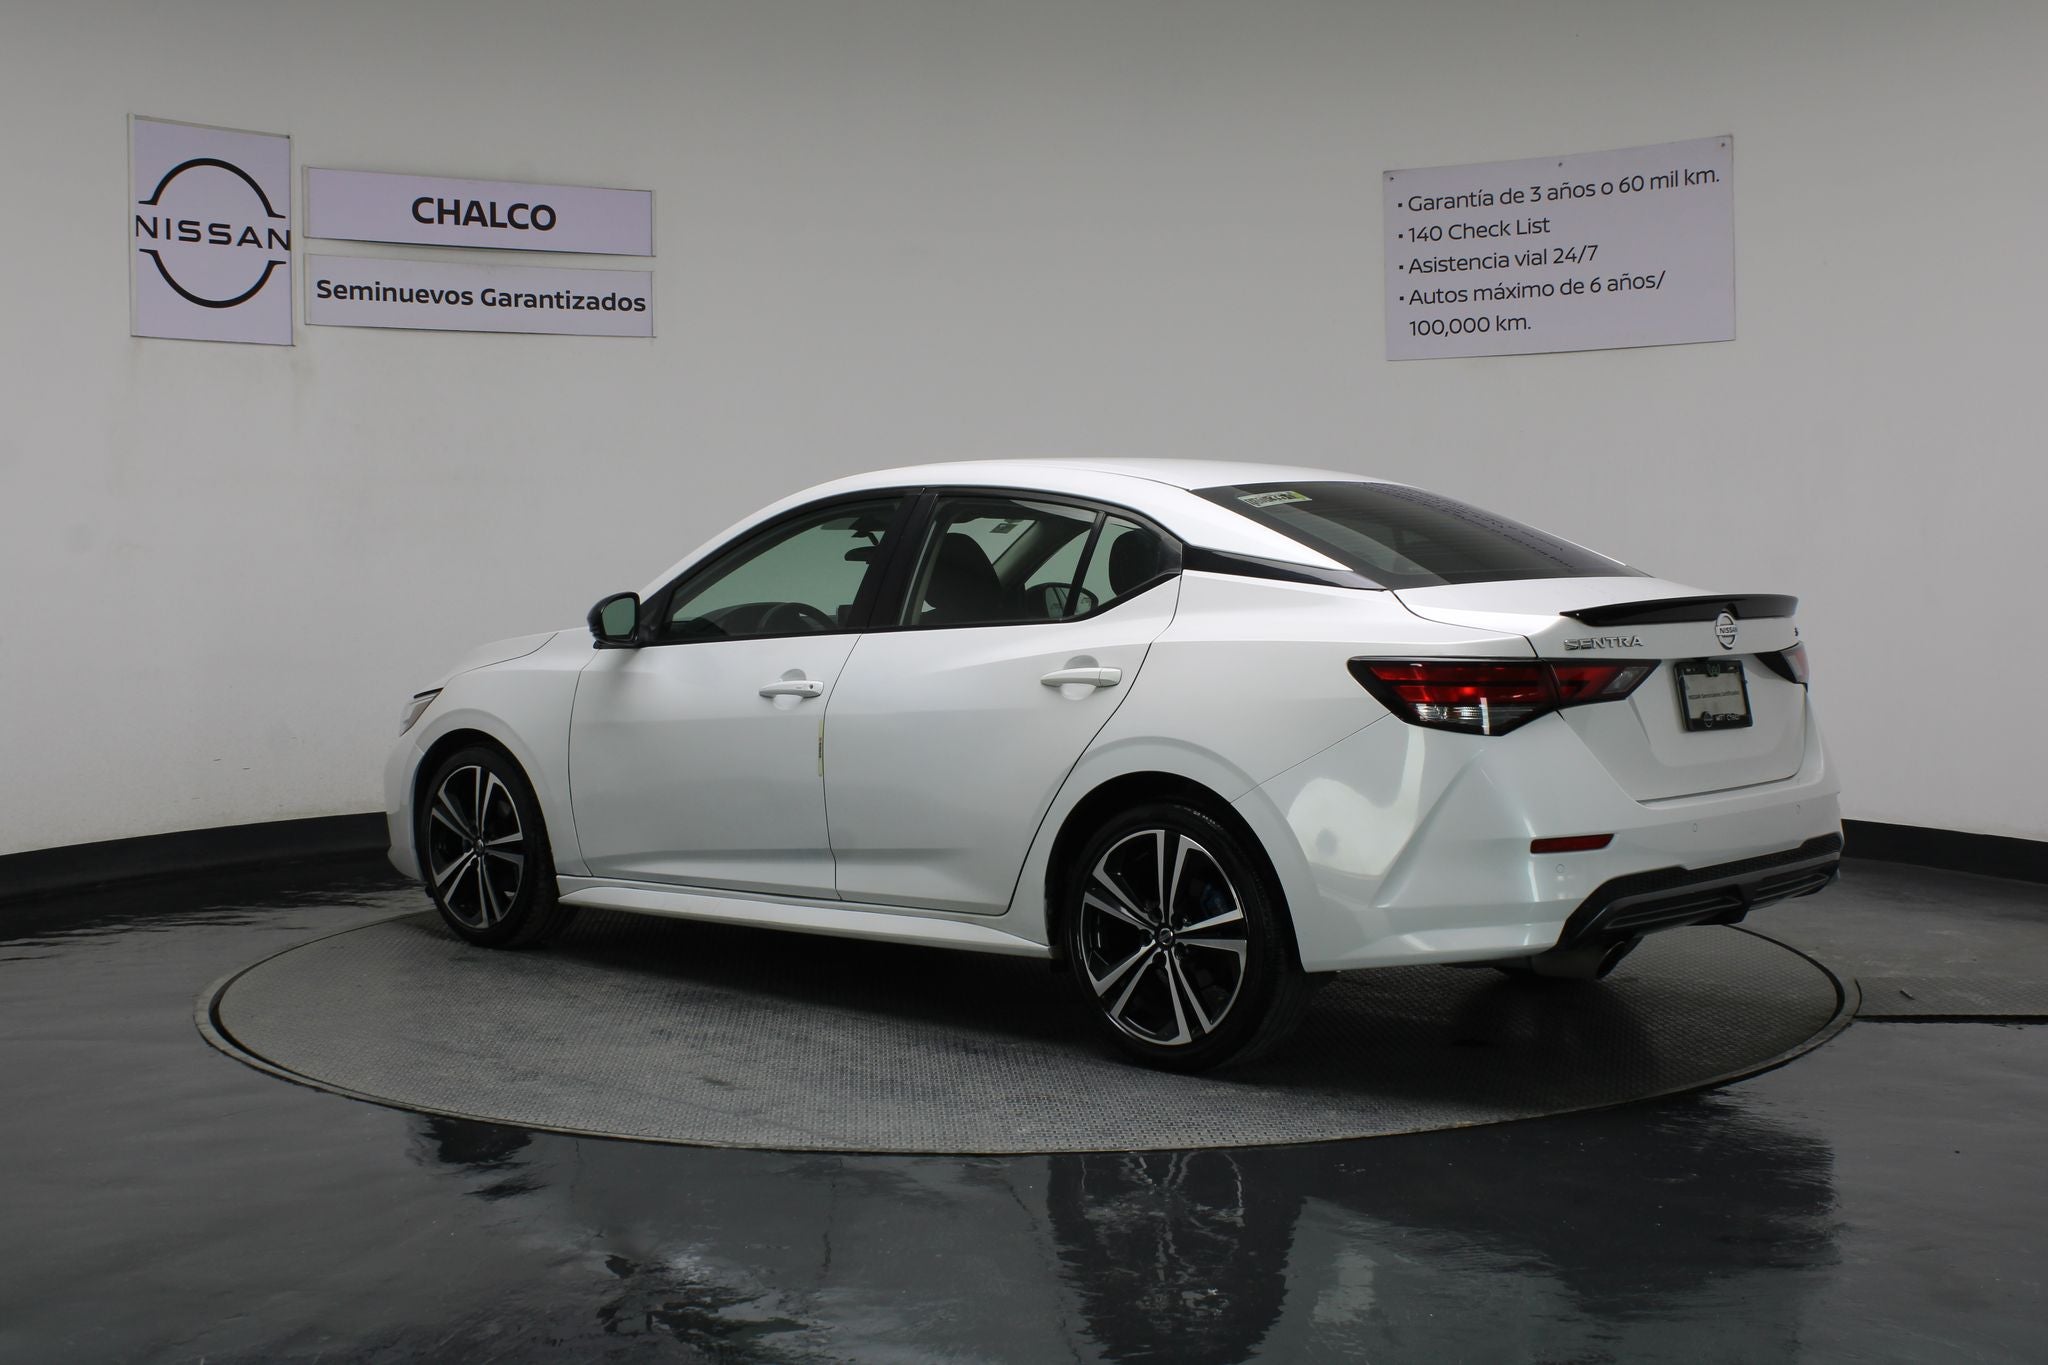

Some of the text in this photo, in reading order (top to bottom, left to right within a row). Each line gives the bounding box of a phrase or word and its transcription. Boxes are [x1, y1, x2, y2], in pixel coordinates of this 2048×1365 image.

[1407, 168, 1720, 212] Garantía de 3 años o 60 mil km.
[411, 196, 557, 232] CHALCO
[1407, 217, 1551, 243] 140 Check List
[135, 214, 291, 251] NISSAN
[1408, 244, 1599, 275] Asistencia vial 24/7
[316, 279, 647, 313] Seminuevos Garantizados
[1408, 269, 1667, 306] Autos máximo de 6 años/
[1408, 314, 1532, 338] 100,000 km.
[1564, 635, 1644, 651] SENTRA
